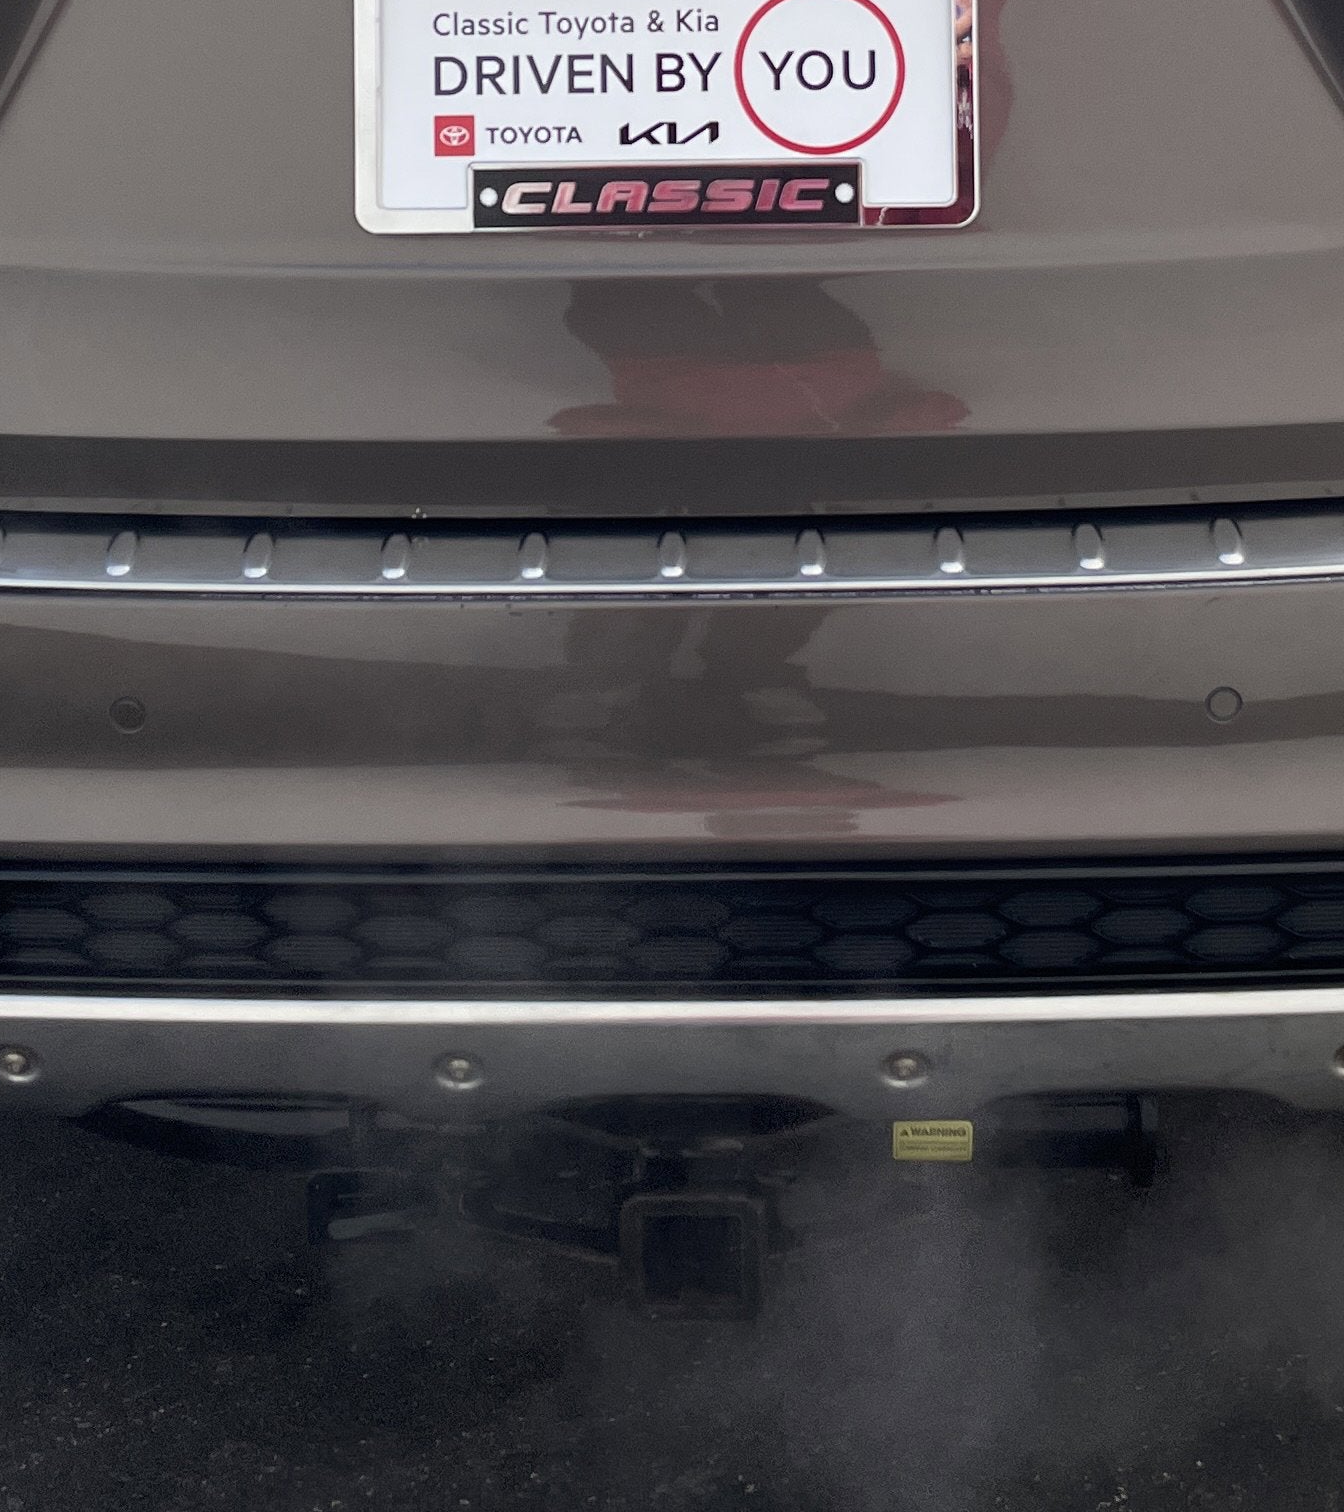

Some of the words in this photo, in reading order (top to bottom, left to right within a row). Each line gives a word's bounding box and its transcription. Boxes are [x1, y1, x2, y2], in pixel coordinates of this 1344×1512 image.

[433, 11, 529, 37] Classic
[538, 10, 636, 40] Toyota
[647, 9, 665, 33] &
[676, 8, 720, 33] Kia
[433, 53, 635, 96] DRIVEN
[655, 52, 723, 92] BY
[758, 49, 877, 91] YOU
[485, 126, 583, 145] TOYOTA
[619, 121, 720, 146] KIA
[501, 177, 830, 215] CLASSIC
[910, 1126, 967, 1137] WARNING
